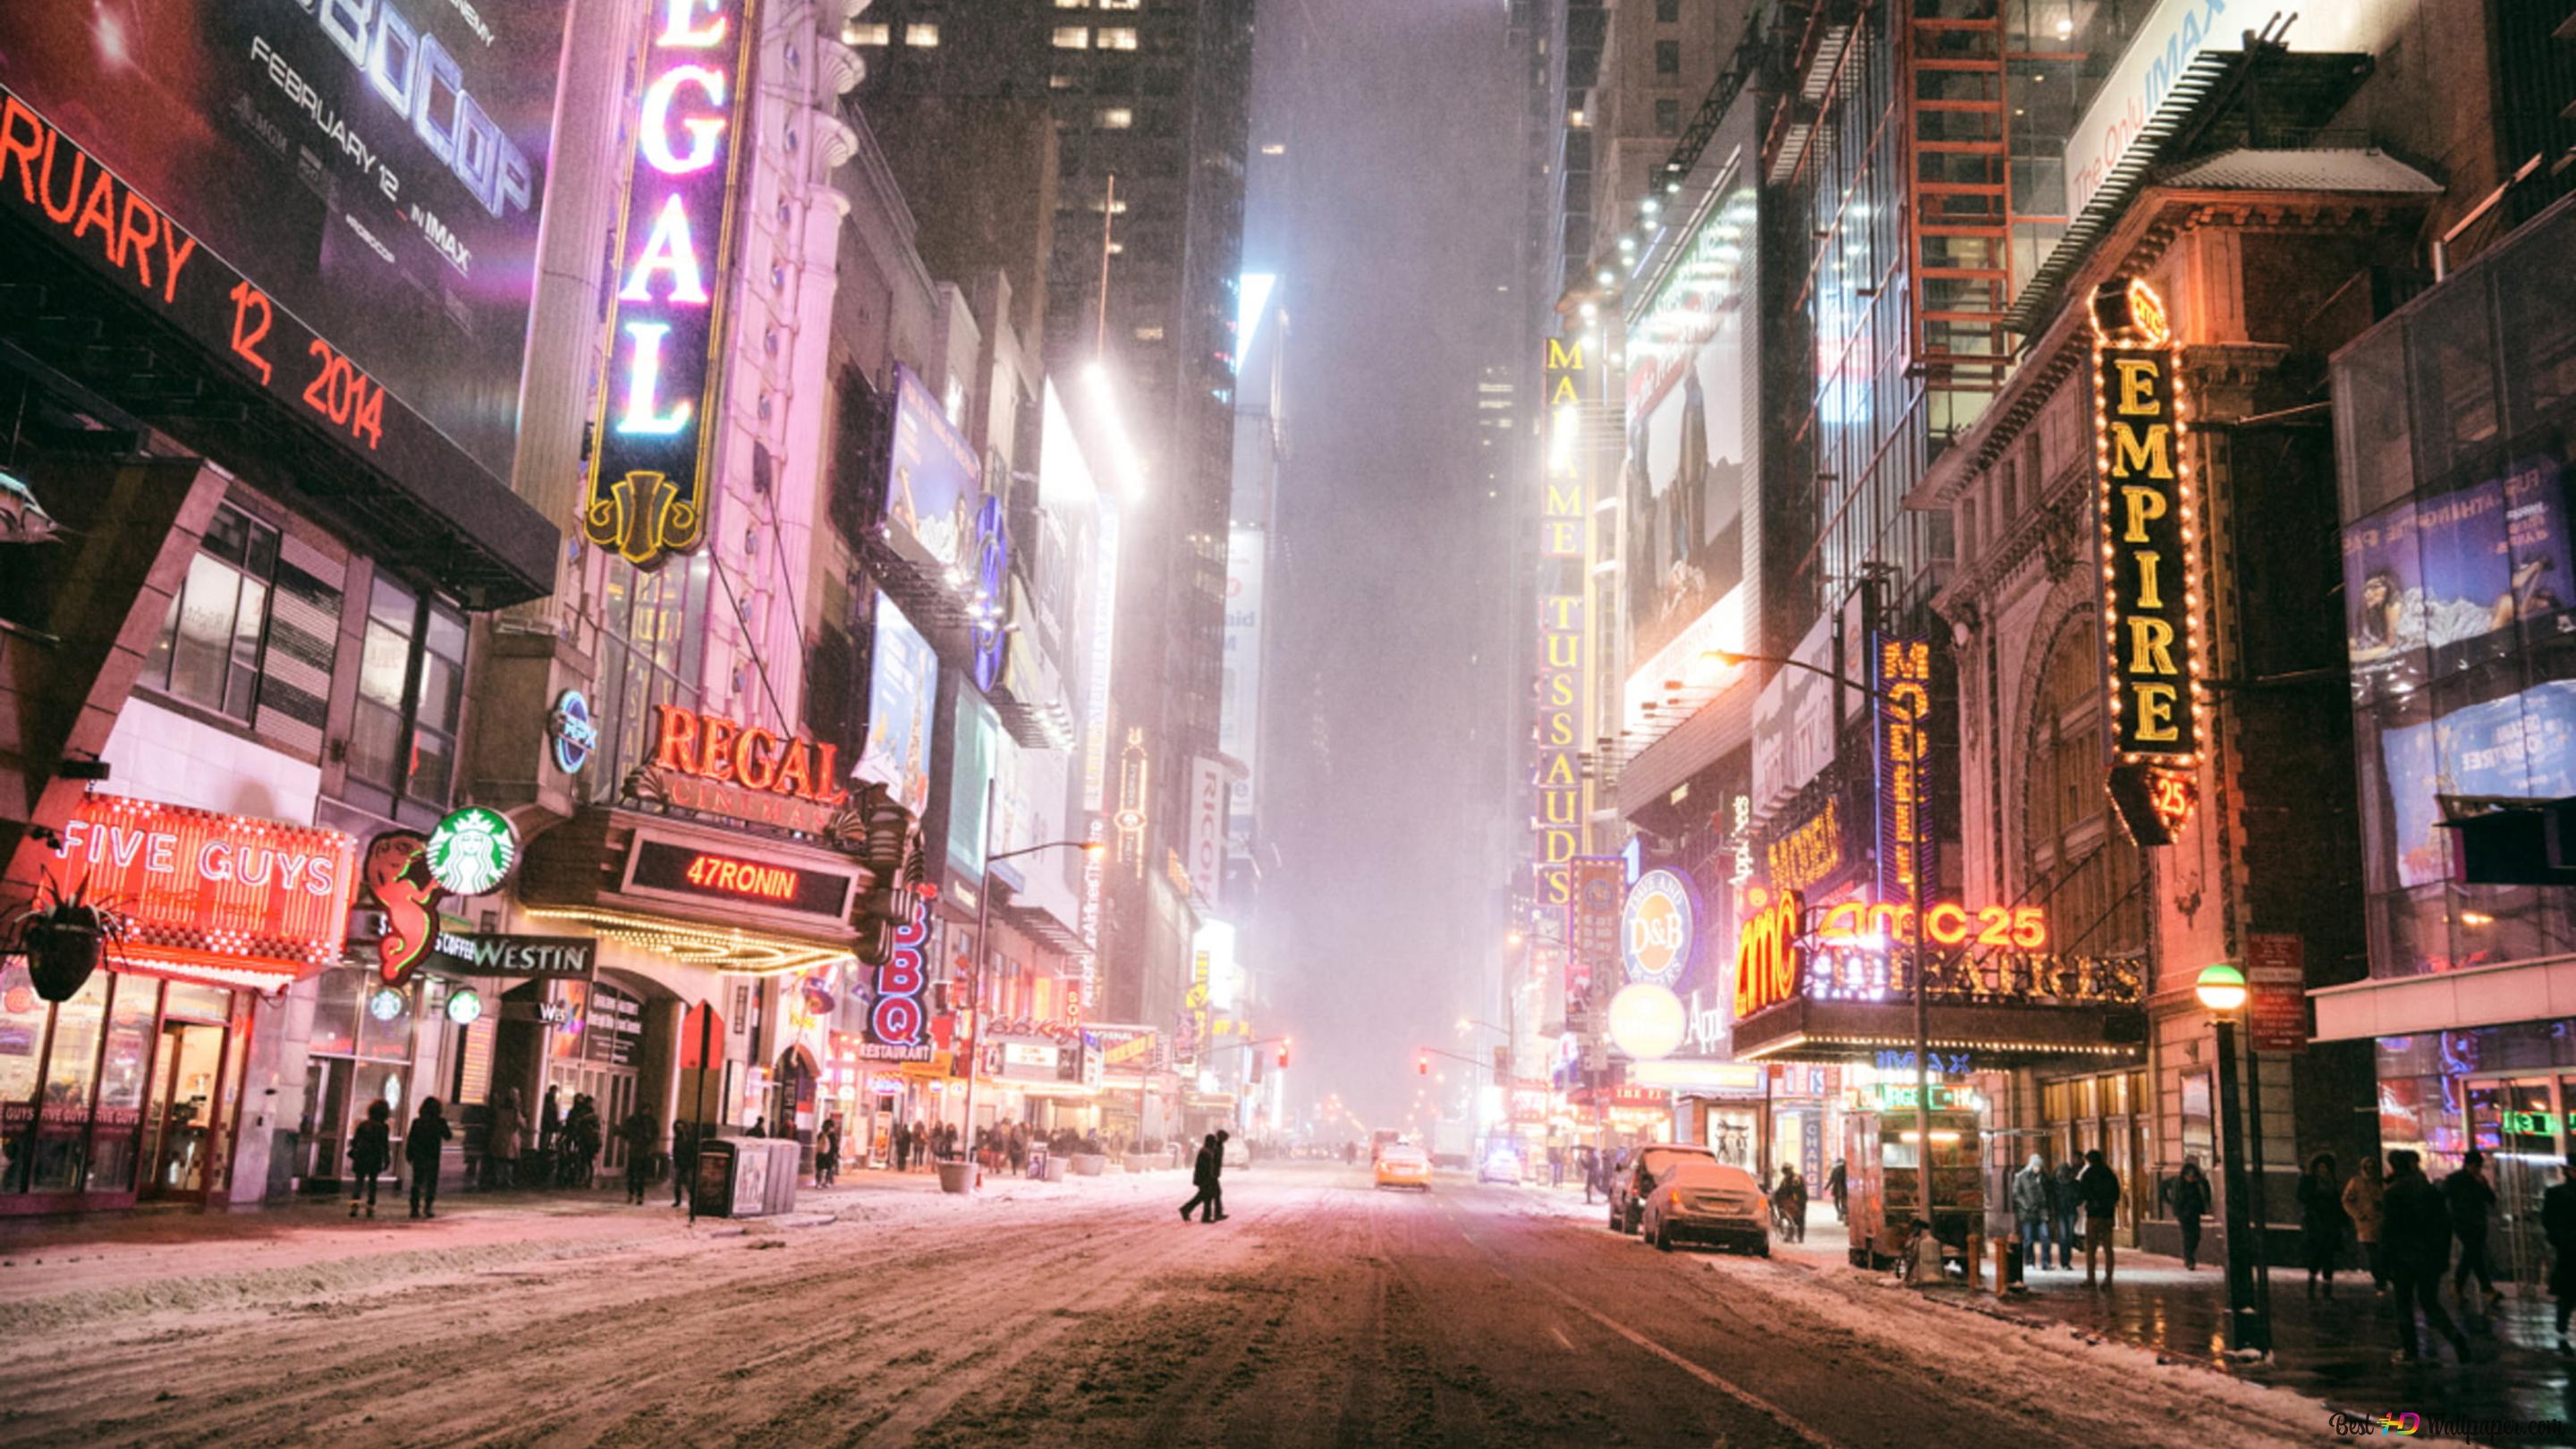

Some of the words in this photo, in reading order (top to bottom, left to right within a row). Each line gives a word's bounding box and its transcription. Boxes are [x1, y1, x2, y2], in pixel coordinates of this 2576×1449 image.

[250, 36, 376, 174] FEBRUARY
[378, 164, 400, 203] 12
[2075, 162, 2101, 203] The
[2105, 94, 2144, 167] Only
[424, 211, 471, 274] IMAX
[303, 338, 386, 449] 2014
[1546, 337, 1584, 554] MAAME
[2113, 360, 2179, 741] EMPIRE
[654, 703, 849, 804] REGAL
[673, 779, 829, 829] CINEMAS
[2157, 779, 2185, 816] 25
[55, 820, 180, 873] FIVE
[198, 839, 335, 897] GUYS
[473, 939, 588, 970] WESTIN
[1628, 912, 1683, 956] D&B
[1733, 890, 1795, 1018] amc
[1818, 901, 1968, 945] amc
[1978, 905, 2046, 948] 25
[1877, 1048, 1971, 1074] IMAX
